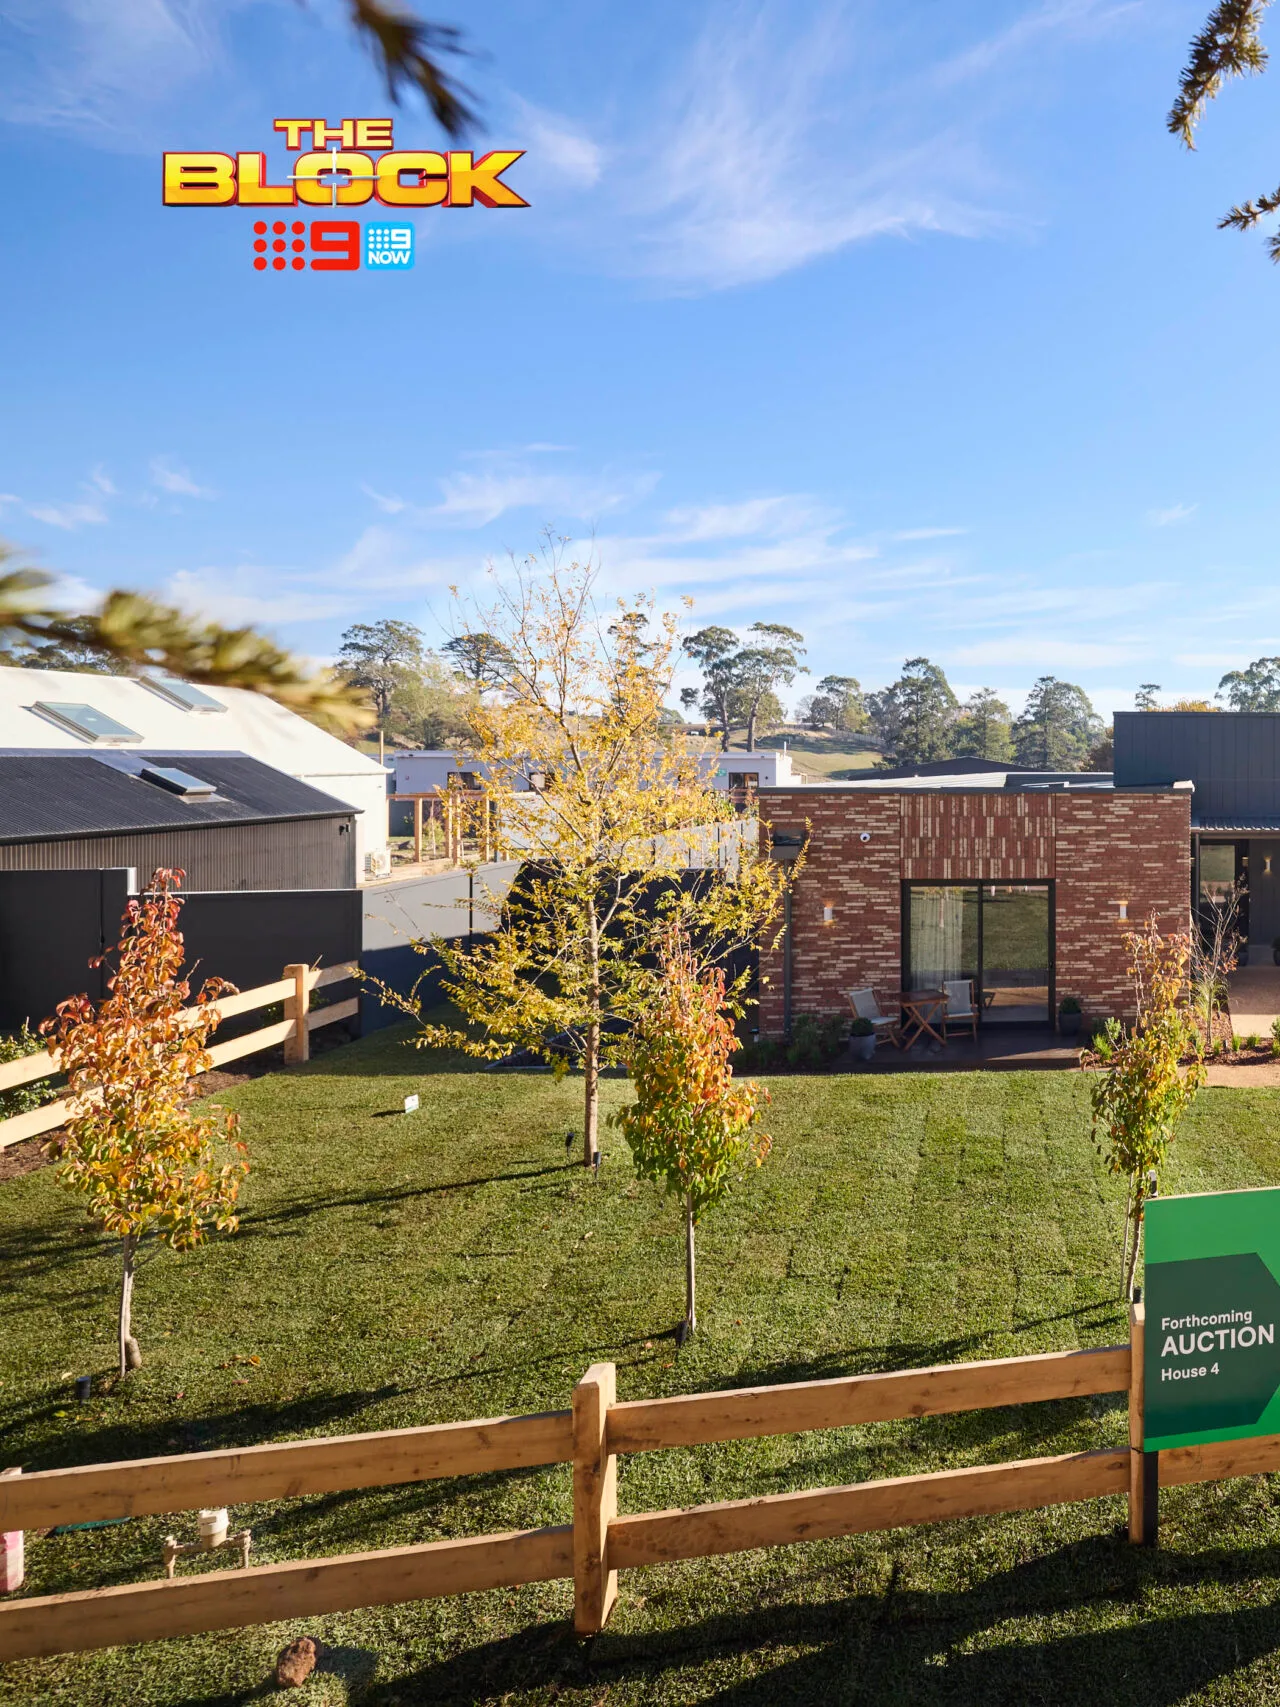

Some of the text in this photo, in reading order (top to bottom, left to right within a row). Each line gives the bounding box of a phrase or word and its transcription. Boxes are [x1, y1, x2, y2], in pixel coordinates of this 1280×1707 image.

[1161, 1310, 1253, 1331] Forthcoming
[1161, 1323, 1275, 1357] AUCTION
[1161, 1362, 1220, 1381] House 4
